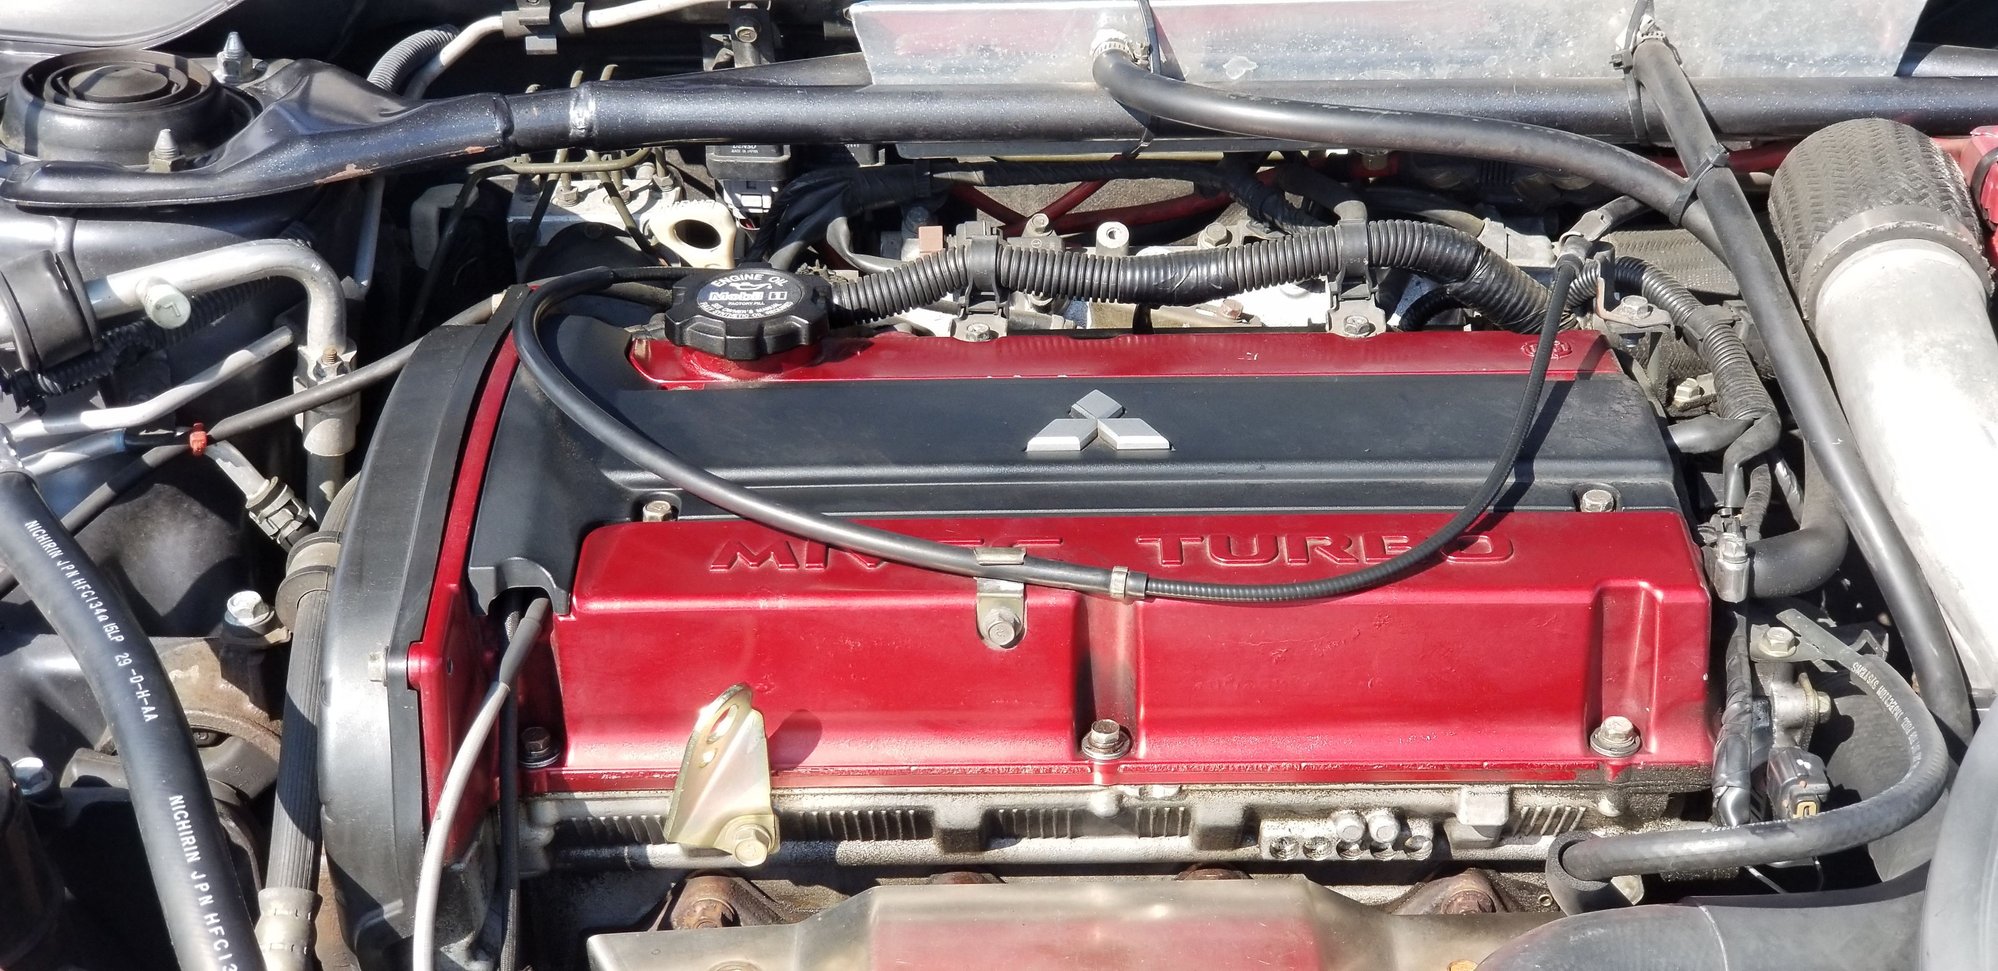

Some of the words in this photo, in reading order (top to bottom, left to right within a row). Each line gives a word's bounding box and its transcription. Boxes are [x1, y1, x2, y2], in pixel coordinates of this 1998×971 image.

[708, 292, 764, 300] Mobil
[711, 273, 764, 288] ENGINE
[768, 276, 788, 286] OIL
[1136, 533, 1514, 568] TURBO
[24, 519, 64, 560] NICHIRIN
[57, 559, 80, 580] JPN
[114, 652, 132, 667] 29
[1851, 662, 1880, 690] SYSTEMS
[168, 794, 200, 864] NICHIRIN
[190, 871, 214, 906] JPN
